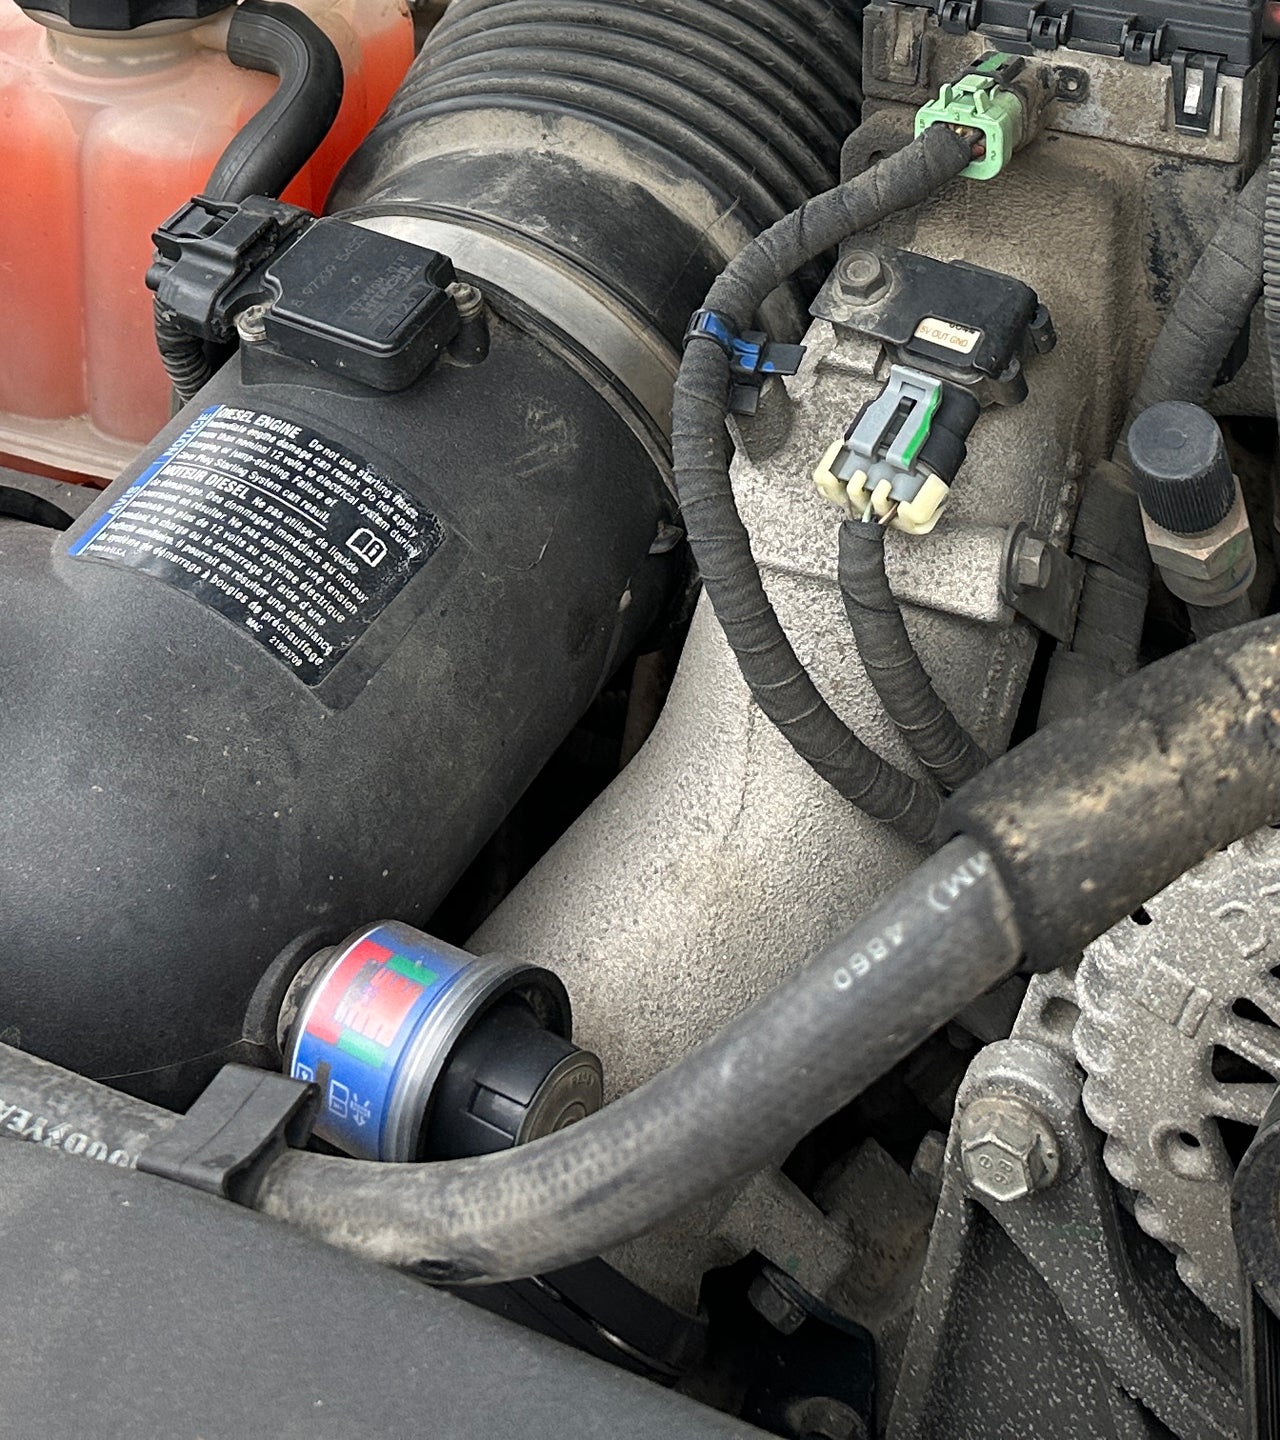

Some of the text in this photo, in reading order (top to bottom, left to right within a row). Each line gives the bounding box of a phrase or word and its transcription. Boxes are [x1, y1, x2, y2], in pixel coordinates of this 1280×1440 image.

[931, 328, 951, 341] OUT
[949, 335, 969, 348] GND
[163, 412, 213, 457] NOTICE
[216, 407, 393, 499] DIESEL ENGINE Do not use starting
[229, 449, 291, 481] jump-starting.
[291, 475, 325, 500] Failure
[324, 498, 339, 508] of
[107, 485, 141, 515] AVIS
[160, 464, 360, 575] MOTEUR DIESEL Ne pas utiliser de liquide
[214, 458, 331, 524] Starting System can result.
[235, 436, 272, 455] nominal
[270, 449, 284, 460] 12
[282, 456, 306, 472] volts
[305, 467, 317, 478] to
[316, 475, 360, 506] electrical
[357, 502, 391, 532] system
[246, 428, 419, 538] engine damage can result. Do not apply
[158, 519, 190, 536] charge
[188, 530, 203, 542] ou
[202, 535, 212, 547] le
[212, 541, 264, 577] démarrage
[271, 577, 300, 603] l'aide
[298, 600, 327, 626] d'une
[163, 506, 346, 624] de plus de 12 volts au système électrique
[175, 538, 184, 548] Il
[181, 542, 221, 566] pourrait
[218, 563, 233, 574] en
[230, 571, 270, 598] résulter
[266, 594, 287, 613] une
[205, 492, 225, 505] Des
[223, 500, 274, 530] dommages
[273, 525, 323, 564] immédiats
[321, 561, 337, 575] au
[335, 571, 370, 604] moteur
[227, 516, 243, 529] Ne
[240, 525, 262, 540] pas
[260, 536, 306, 570] appliquer
[304, 566, 325, 586] une
[323, 581, 358, 615] tension
[139, 540, 154, 551] de
[152, 545, 202, 574] démarrage
[209, 574, 249, 604] bougies
[247, 601, 263, 615] de
[260, 611, 324, 669] préchauffage.
[245, 616, 264, 633] MAC
